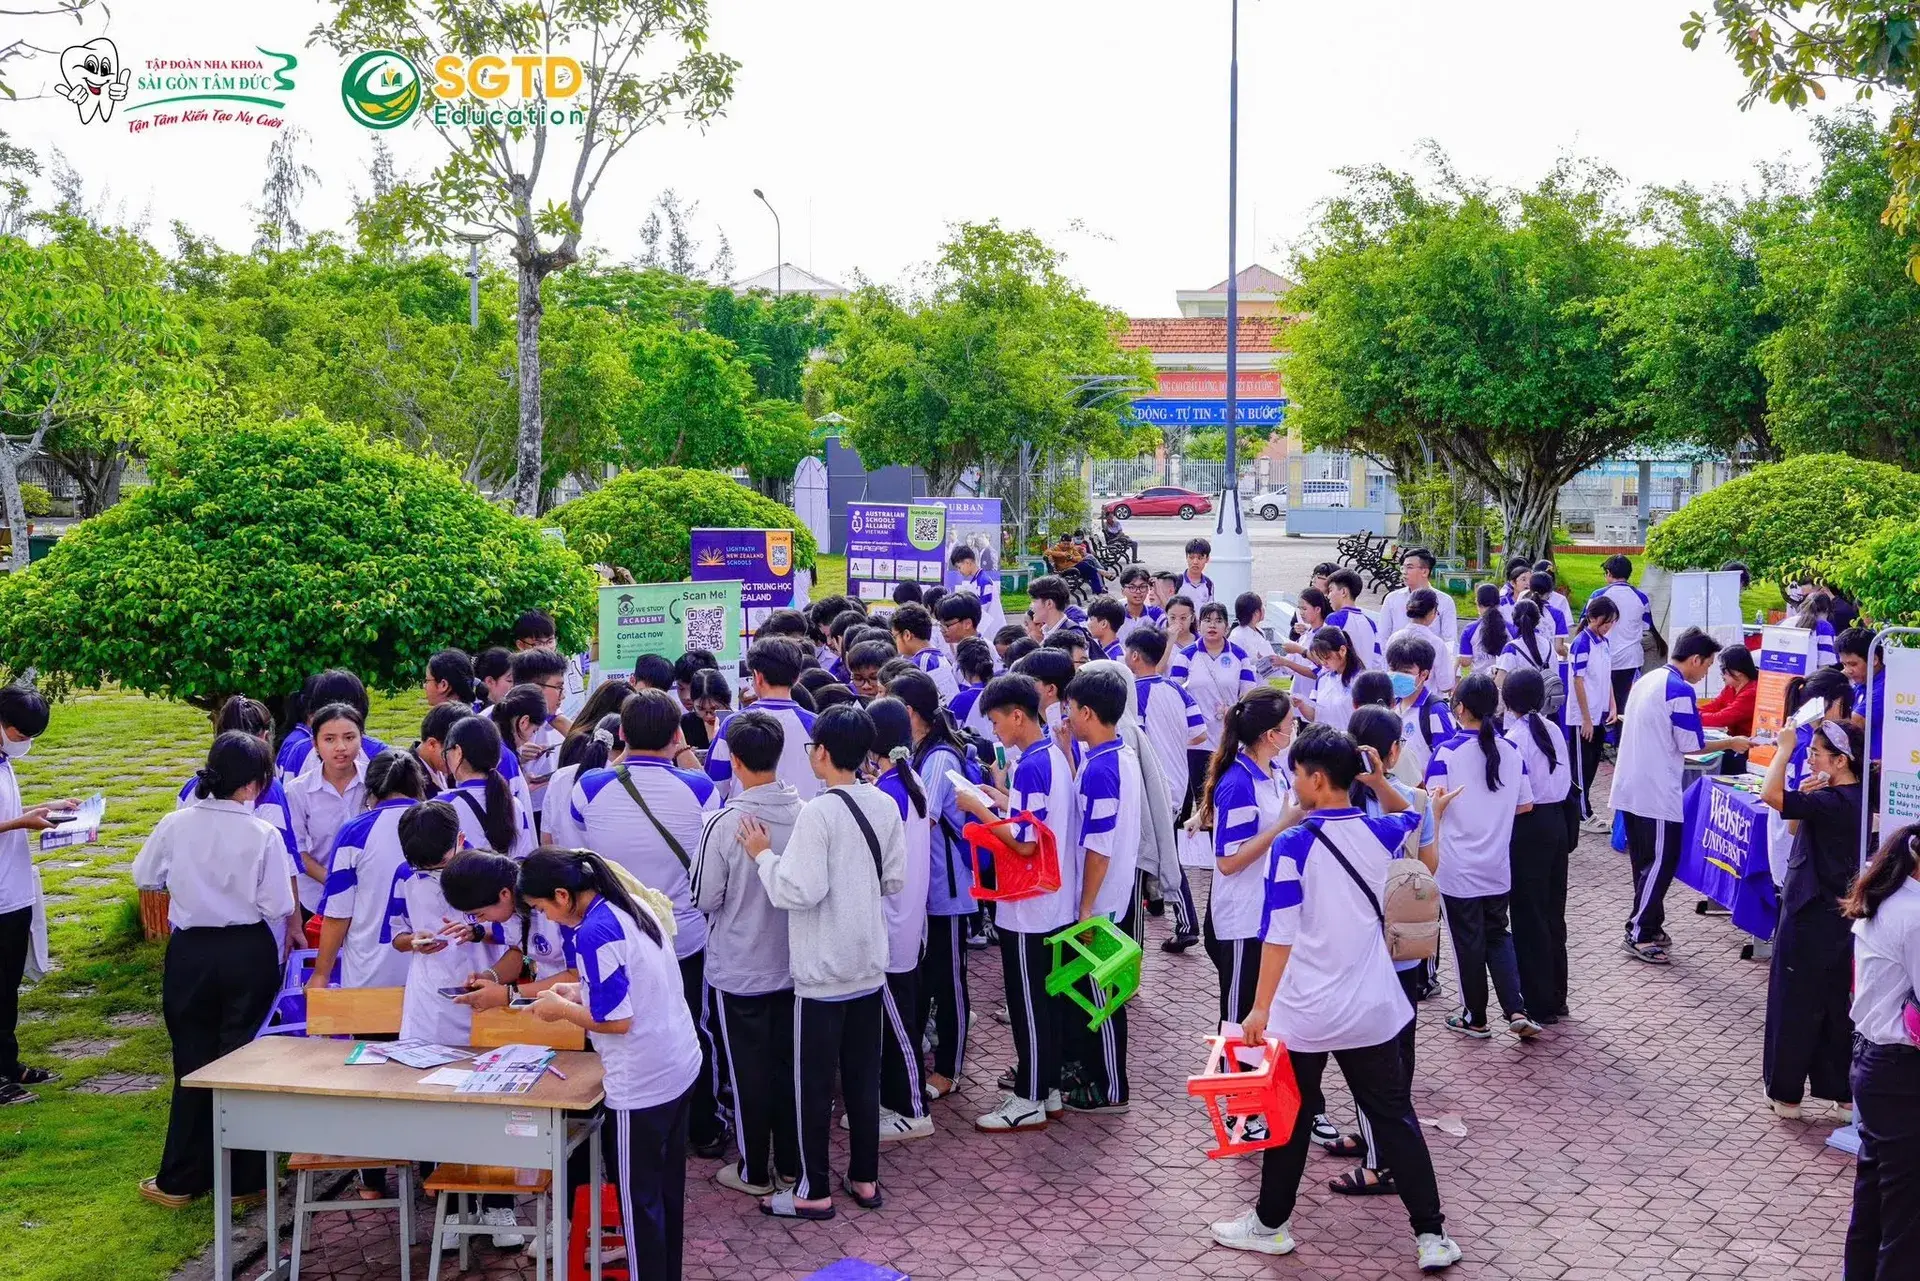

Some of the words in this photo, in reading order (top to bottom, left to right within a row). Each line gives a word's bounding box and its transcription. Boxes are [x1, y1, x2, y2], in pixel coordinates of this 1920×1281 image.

[1176, 405, 1191, 422] TỰ
[1193, 408, 1212, 420] TIN
[1220, 403, 1245, 420] TN
[948, 503, 984, 511] URBAN
[752, 583, 776, 591] TRUNG
[777, 583, 792, 592] HỌC
[682, 591, 706, 601] Scan
[710, 590, 727, 599] Me!
[623, 616, 662, 624] ACADEMY
[617, 632, 646, 640] Contact
[647, 631, 664, 639] now
[1897, 791, 1914, 799] Quản
[1710, 786, 1751, 844] Webster
[1896, 809, 1913, 817] Quản
